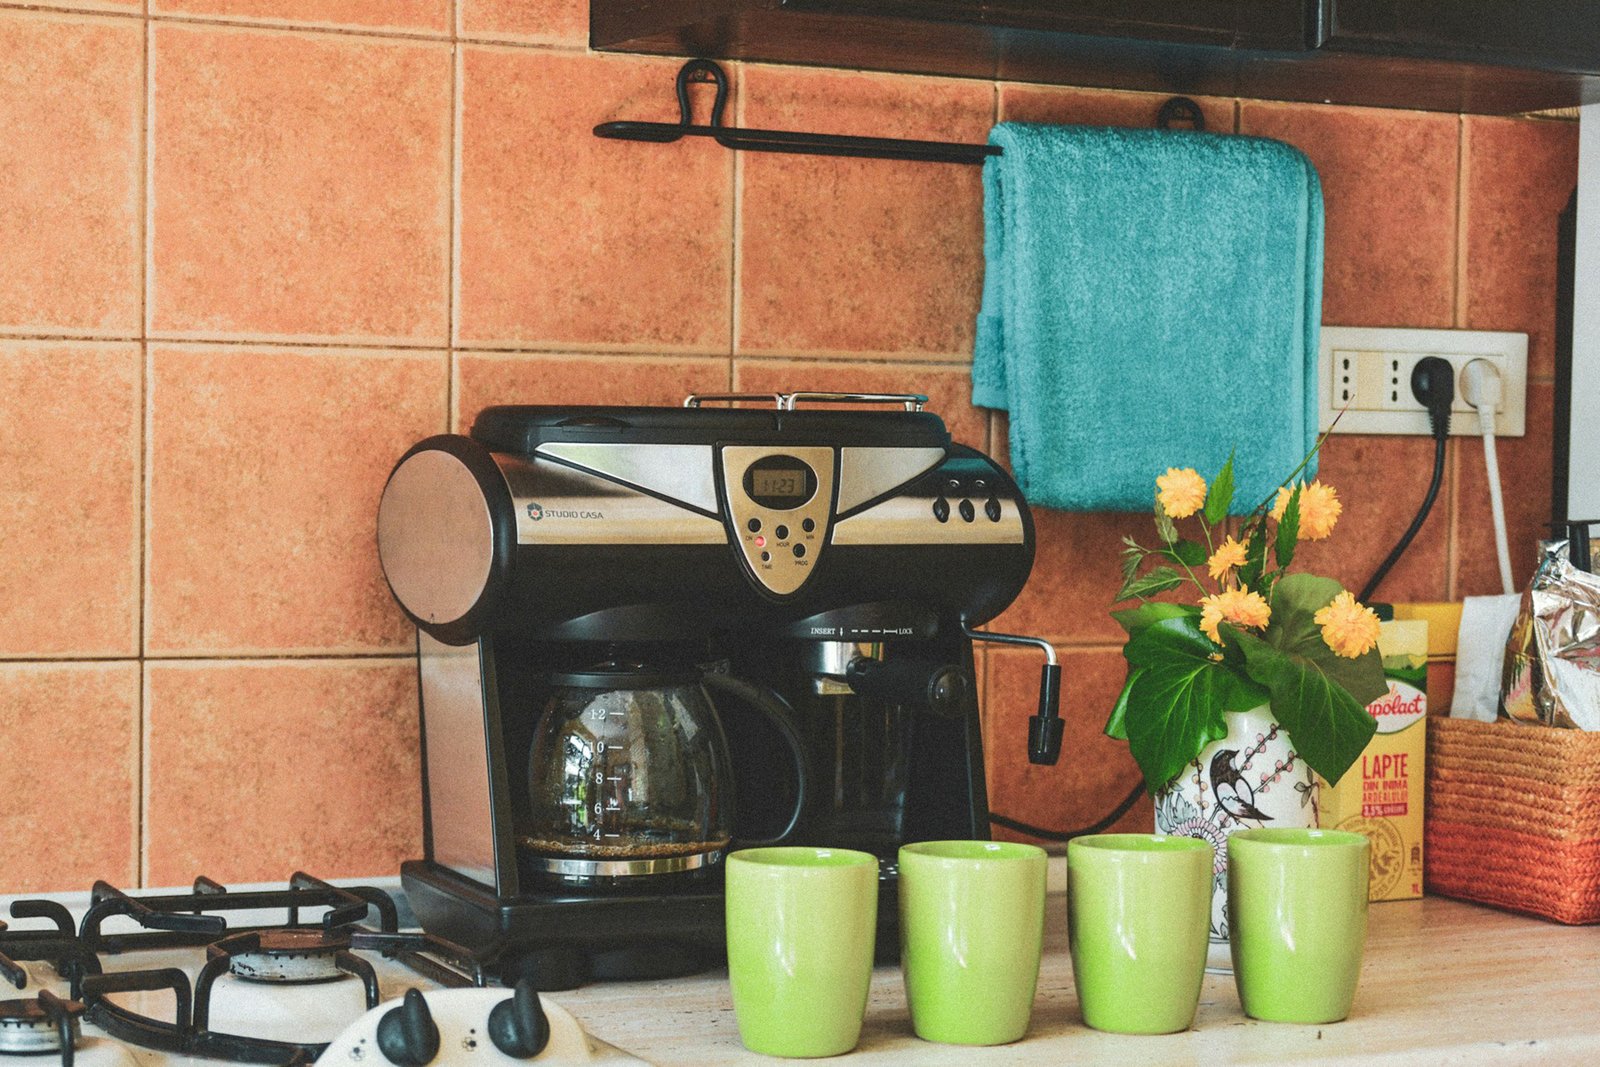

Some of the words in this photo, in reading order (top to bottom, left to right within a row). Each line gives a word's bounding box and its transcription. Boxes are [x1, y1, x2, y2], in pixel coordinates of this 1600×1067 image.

[545, 509, 579, 519] STUDIO
[580, 511, 604, 519] CASA
[810, 627, 836, 635] INSERT
[1364, 694, 1424, 719] apolact
[1362, 752, 1409, 780] LAPTE
[595, 772, 604, 785] 8
[593, 802, 602, 815] 6
[592, 828, 601, 841] 4
